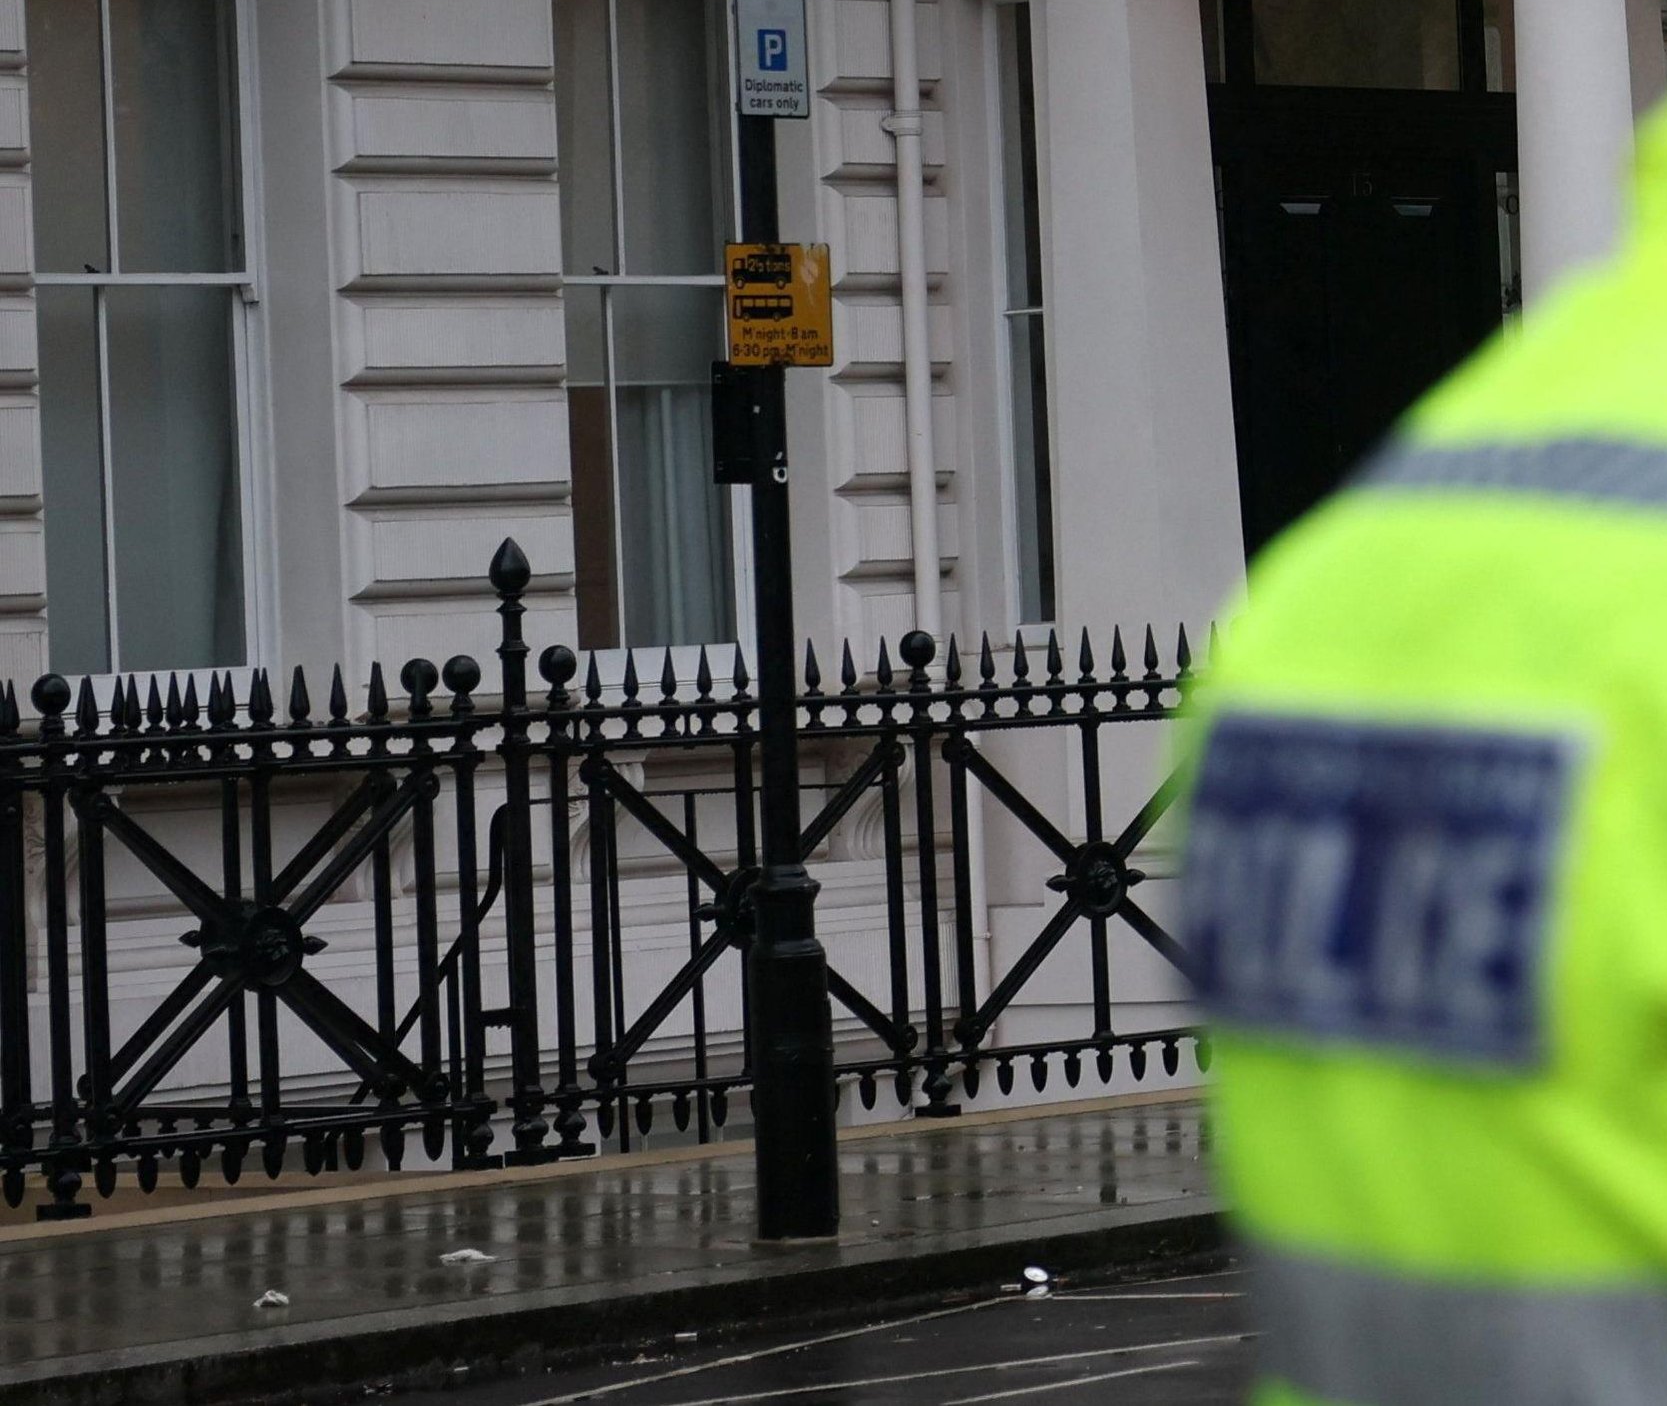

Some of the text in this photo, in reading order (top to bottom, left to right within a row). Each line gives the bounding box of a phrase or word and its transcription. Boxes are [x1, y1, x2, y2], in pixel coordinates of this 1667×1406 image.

[764, 34, 783, 68] P
[745, 79, 803, 93] Diplomatic
[750, 98, 799, 112] cars only
